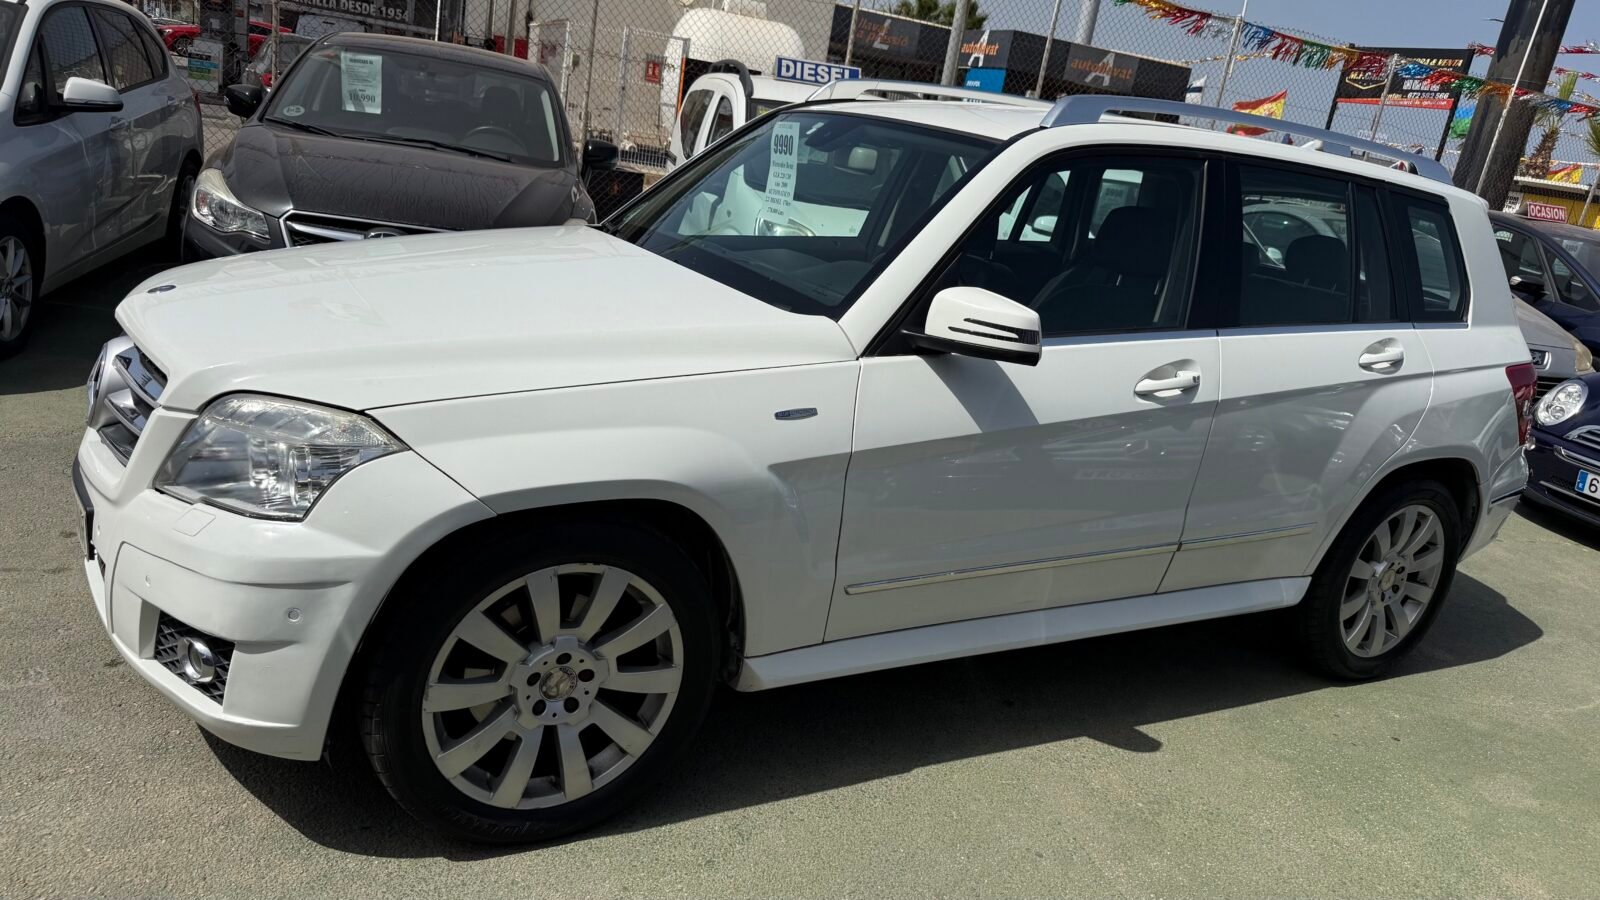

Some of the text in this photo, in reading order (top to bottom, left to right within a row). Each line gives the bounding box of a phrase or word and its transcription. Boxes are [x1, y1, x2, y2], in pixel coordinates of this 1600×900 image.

[341, 0, 376, 16] DESDE
[380, 7, 410, 22] 1954
[1437, 59, 1463, 67] VENTA
[773, 134, 793, 156] 9990
[1530, 204, 1565, 220] OCASION
